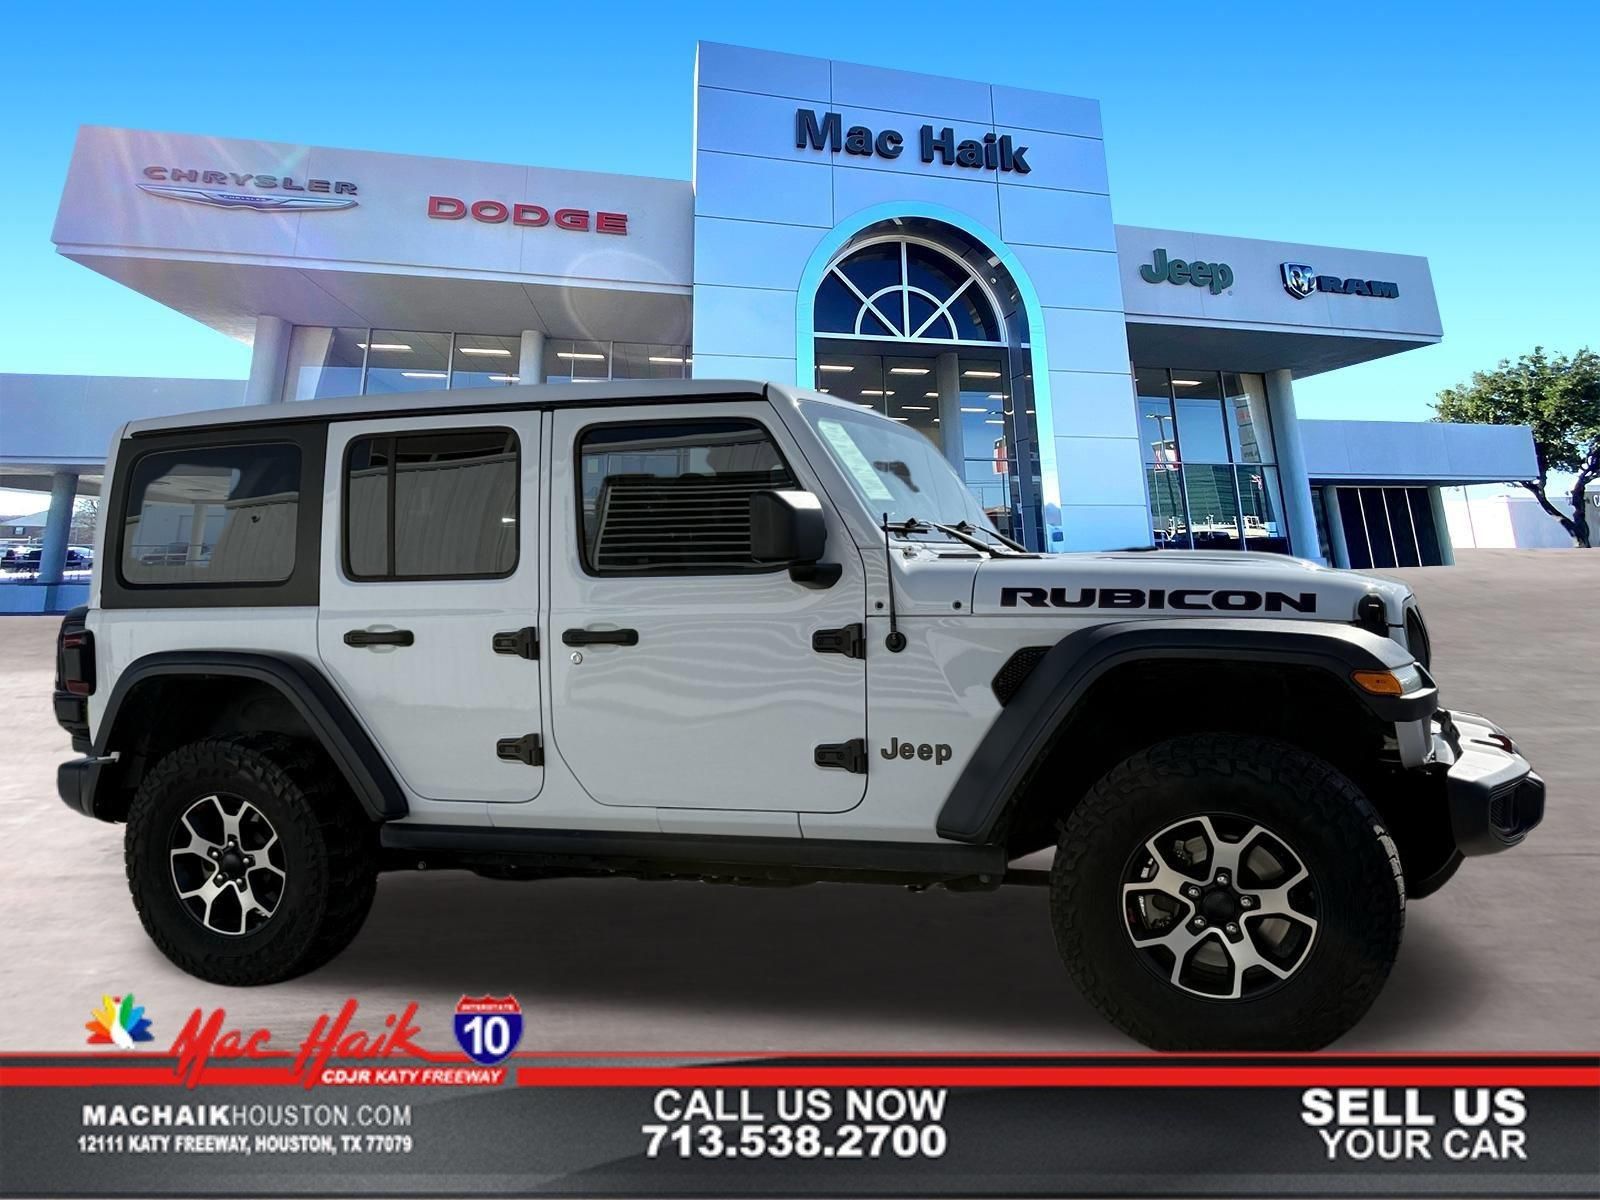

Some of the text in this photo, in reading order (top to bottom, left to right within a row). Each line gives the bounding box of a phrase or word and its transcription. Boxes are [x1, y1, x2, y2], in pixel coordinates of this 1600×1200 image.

[795, 108, 1032, 174] Mac Haik
[143, 165, 359, 196] CHRYSLER
[427, 195, 628, 236] DODGE
[1139, 248, 1234, 296] Jeep
[1315, 275, 1400, 299] RAM
[1000, 586, 1317, 613] RUBICON
[880, 737, 953, 765] Jeep
